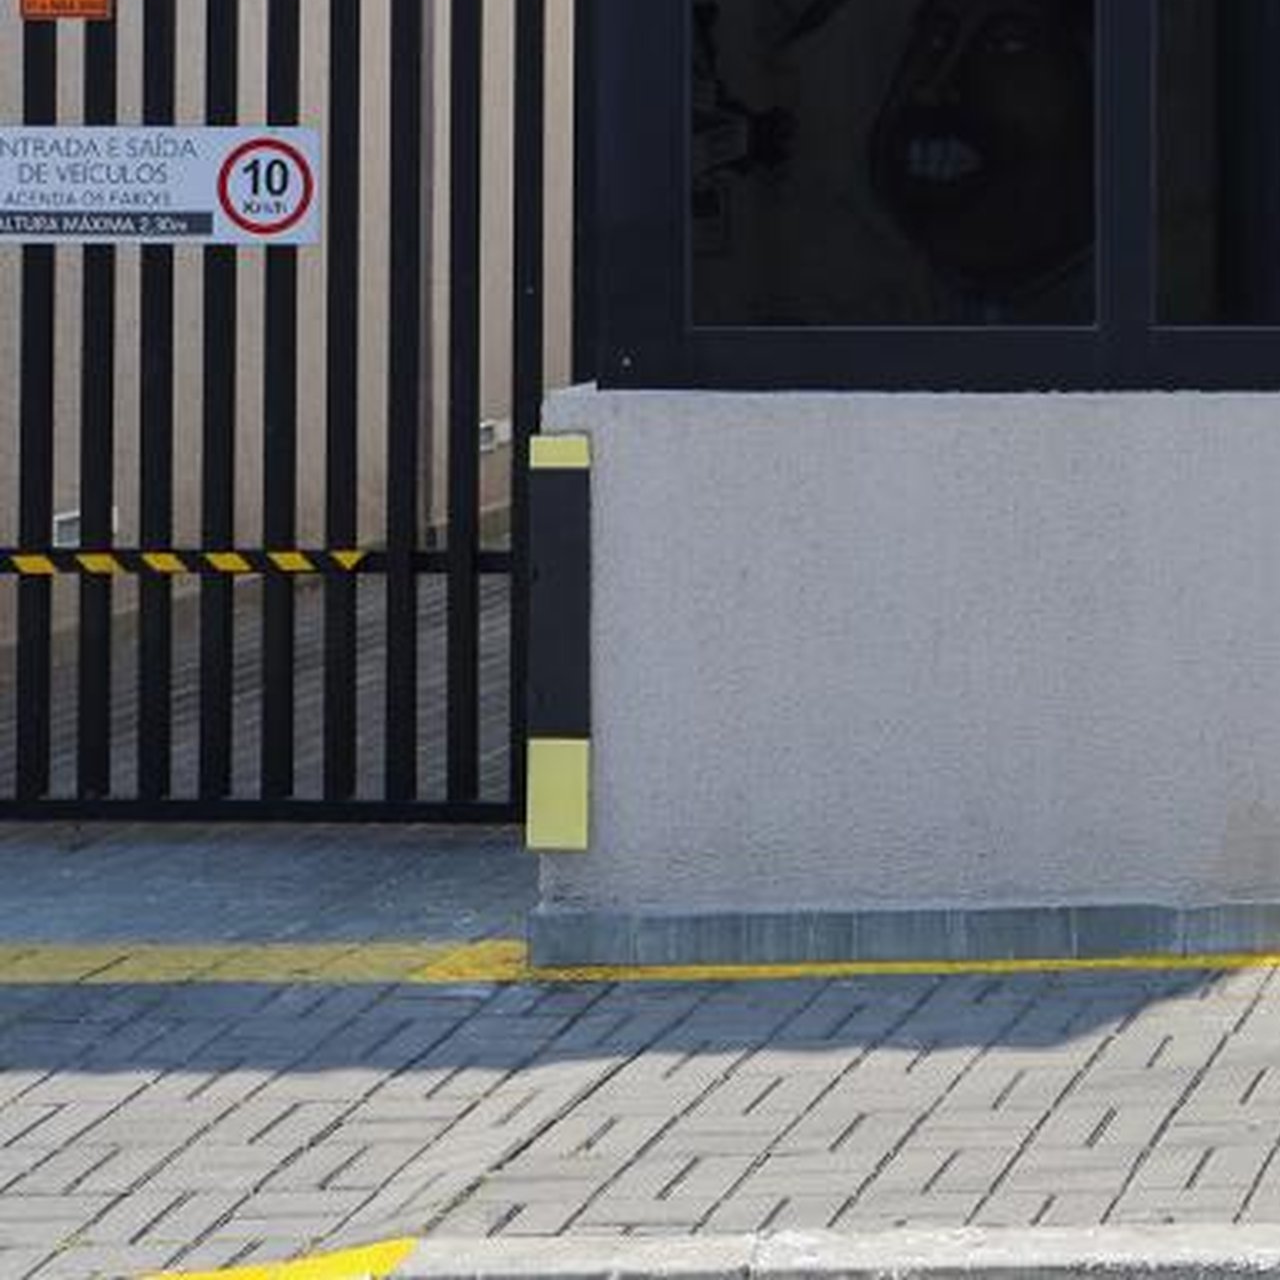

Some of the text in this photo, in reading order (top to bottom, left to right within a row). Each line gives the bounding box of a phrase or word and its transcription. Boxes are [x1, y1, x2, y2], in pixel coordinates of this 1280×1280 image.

[0, 133, 198, 158] NTRADA E SAÍDA
[18, 159, 168, 184] DE VEÍCULOS
[242, 158, 289, 196] 10
[62, 213, 135, 232] MÁXIMA
